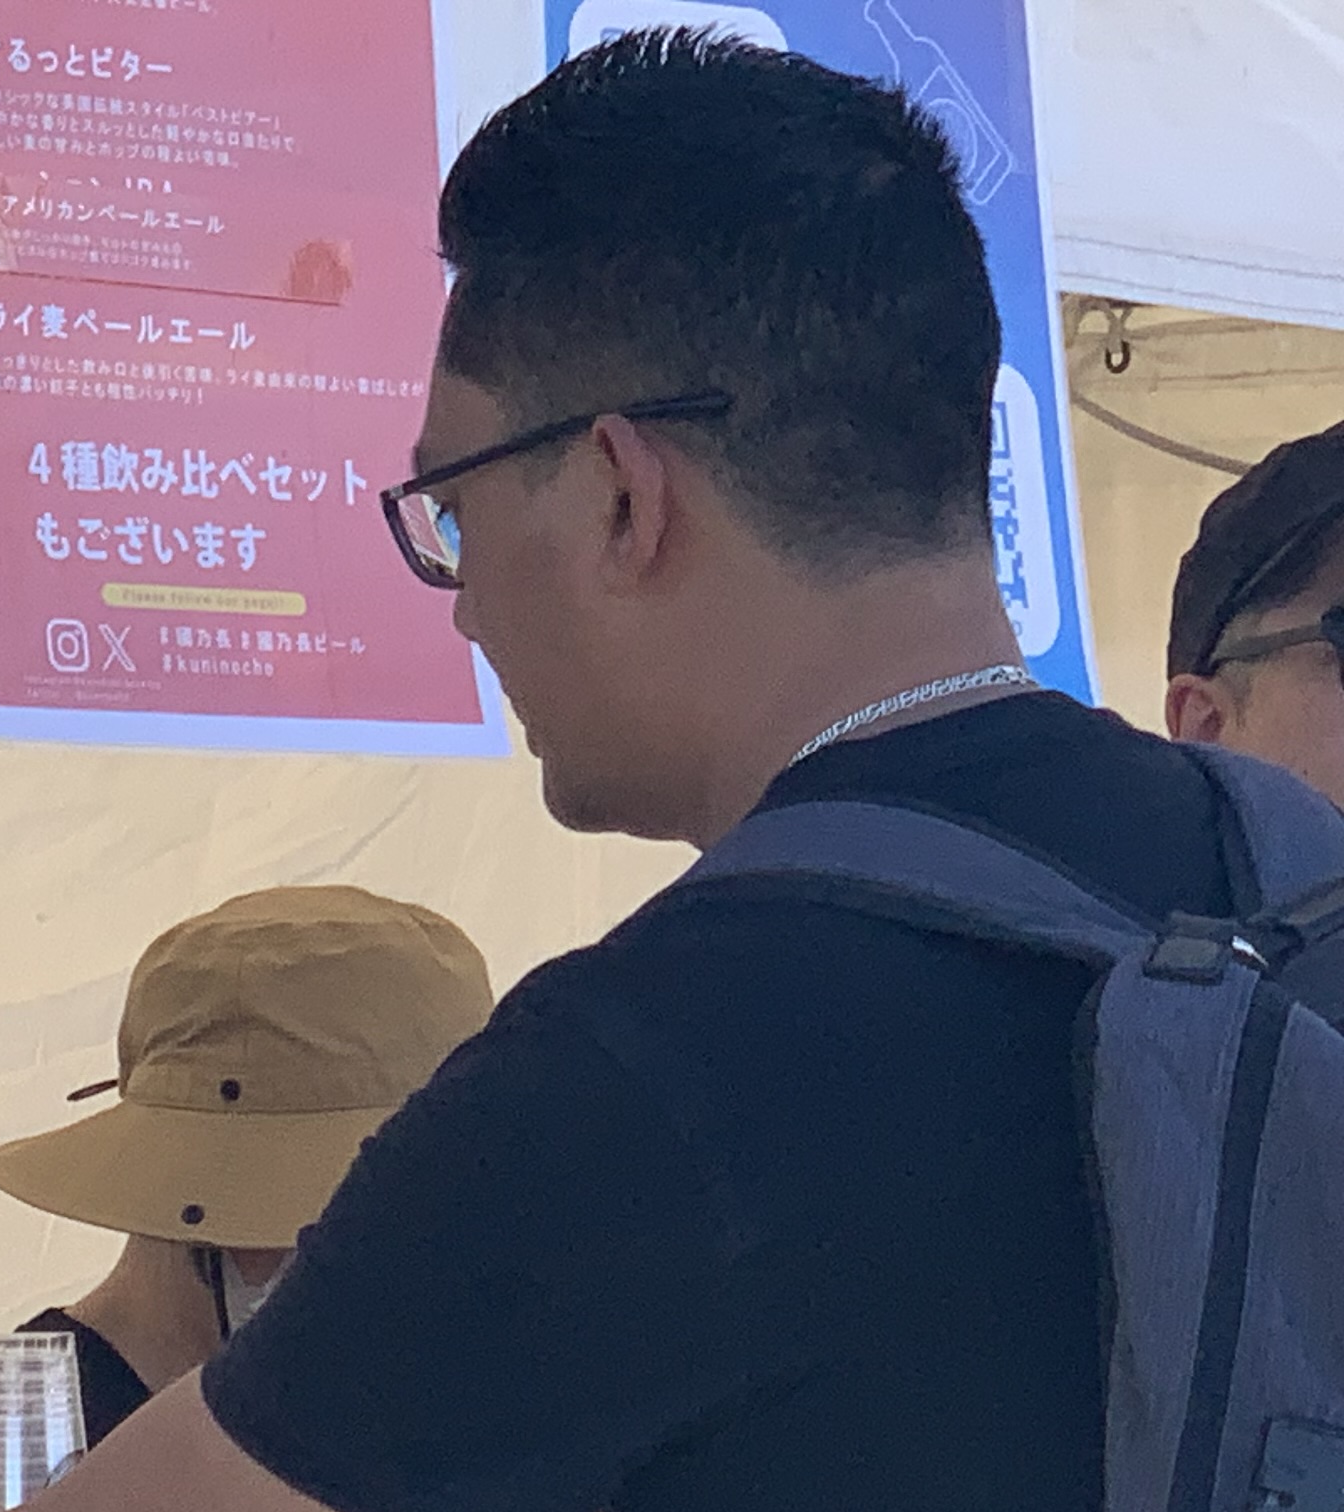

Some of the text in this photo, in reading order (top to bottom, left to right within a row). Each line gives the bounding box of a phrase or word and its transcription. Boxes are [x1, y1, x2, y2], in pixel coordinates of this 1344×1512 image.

[36, 512, 267, 569] もございます
